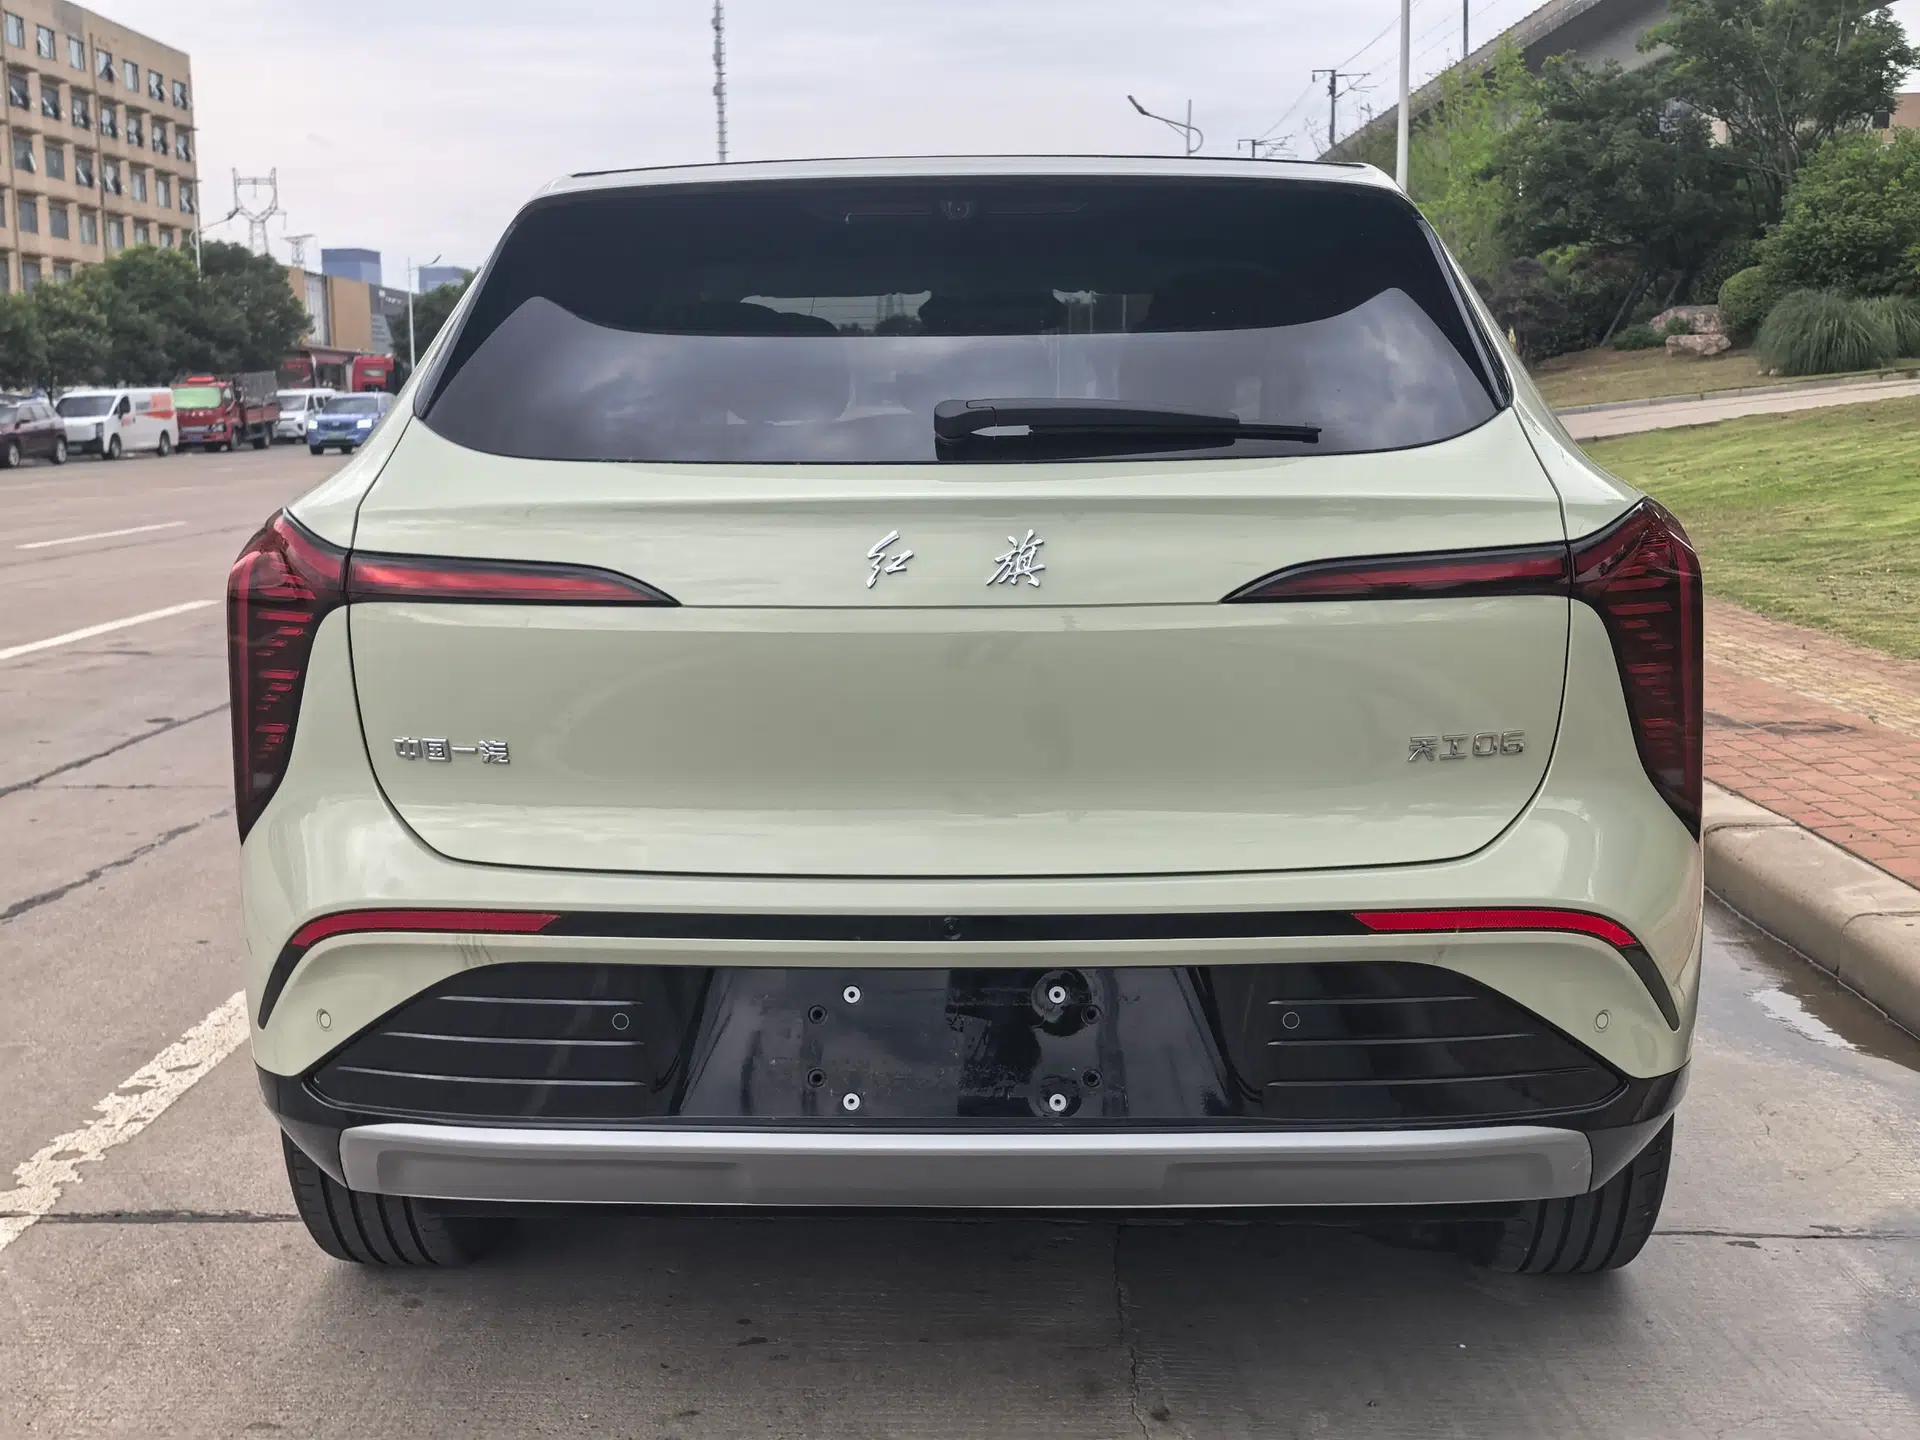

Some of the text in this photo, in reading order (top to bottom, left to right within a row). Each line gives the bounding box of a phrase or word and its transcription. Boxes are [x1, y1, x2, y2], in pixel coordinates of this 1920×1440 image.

[866, 529, 1046, 589] 红旗
[392, 736, 511, 764] 中国一汽
[1408, 730, 1525, 762] 天工06
